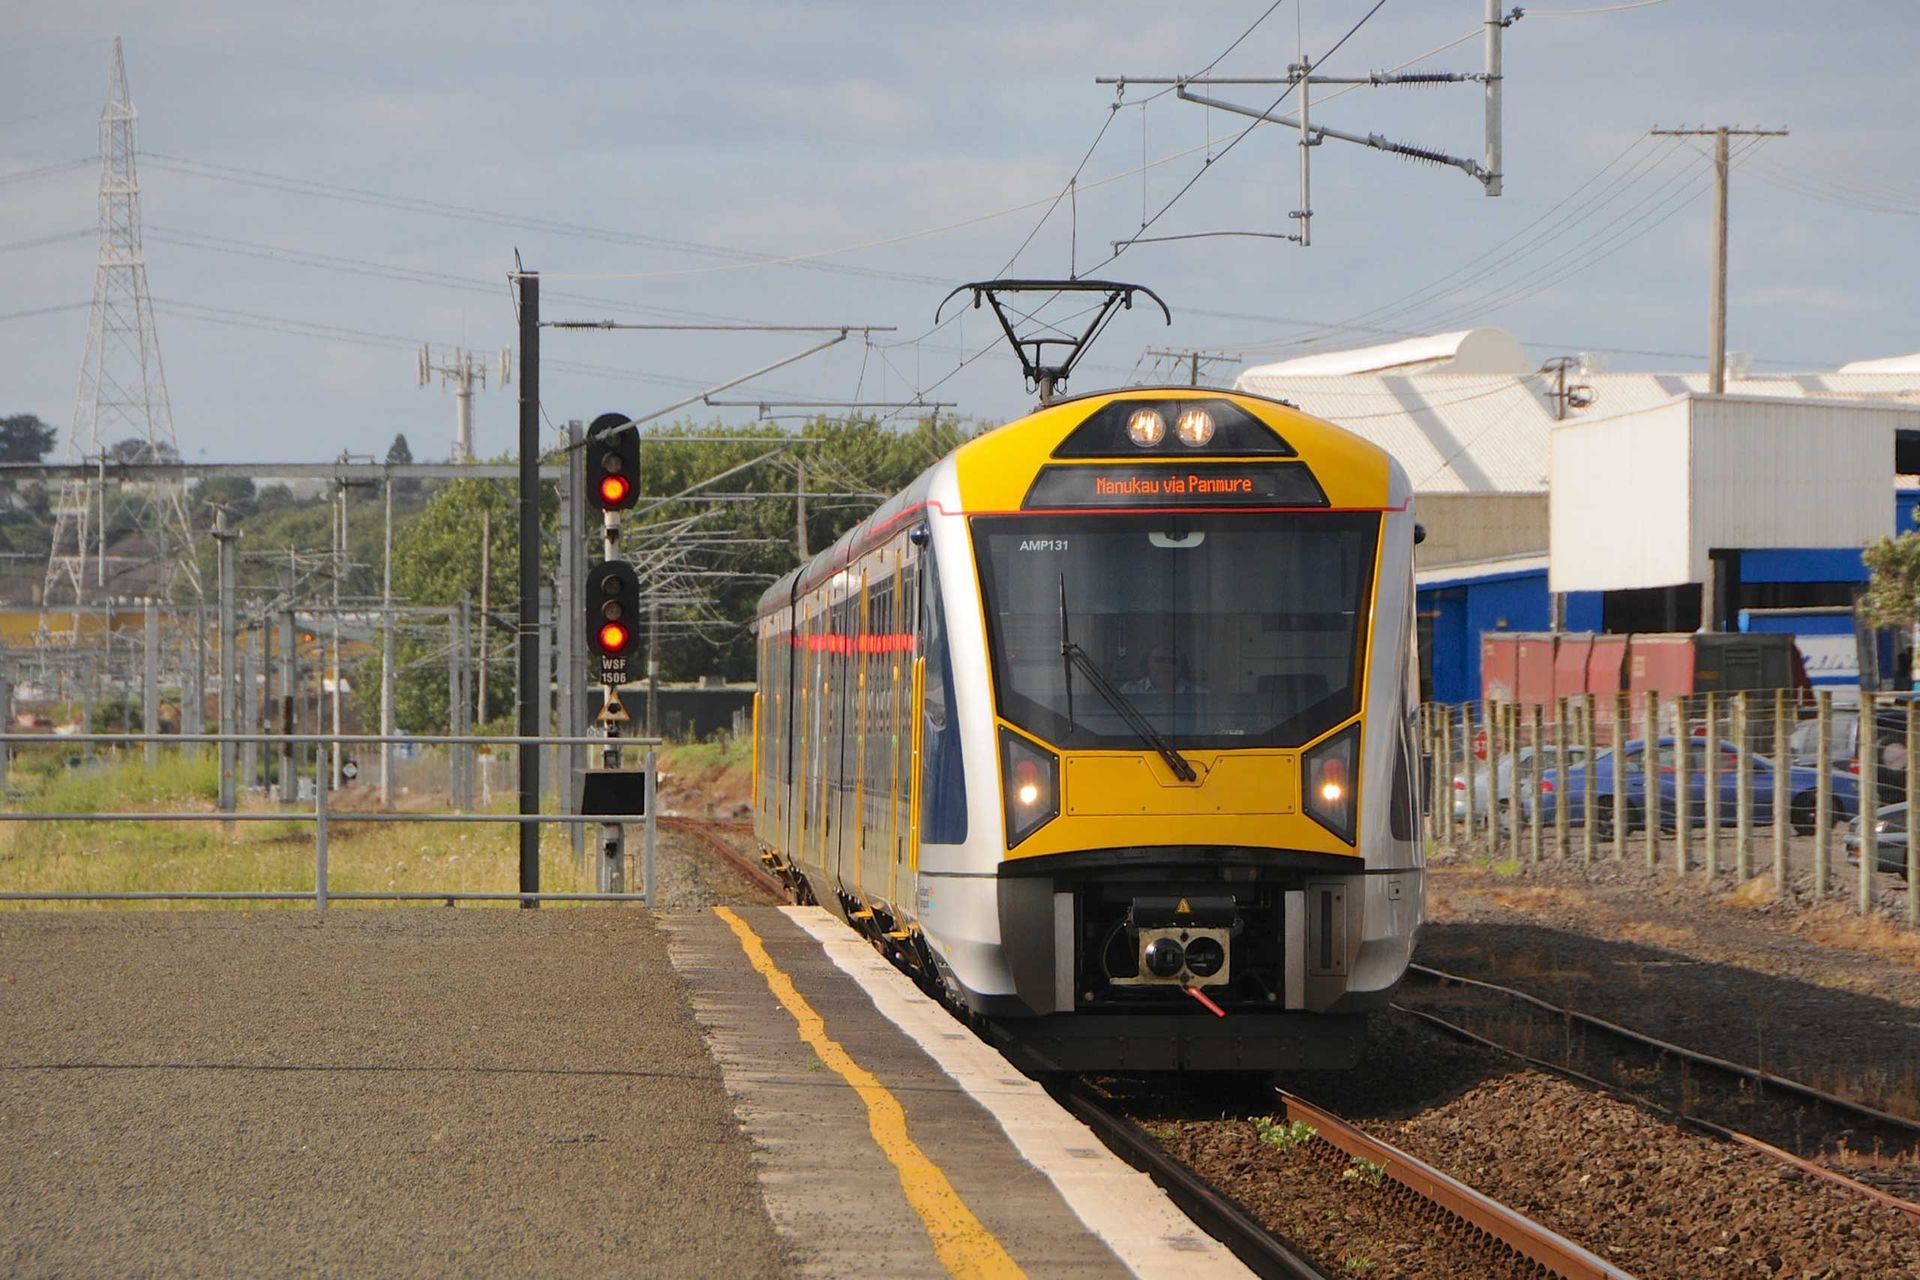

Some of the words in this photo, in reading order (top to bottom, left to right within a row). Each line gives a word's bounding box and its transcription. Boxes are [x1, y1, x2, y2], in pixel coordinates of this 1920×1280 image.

[1096, 477, 1159, 494] Manukau
[1163, 476, 1185, 493] via
[1188, 475, 1252, 492] Panmure
[1019, 540, 1068, 551] AMP131
[602, 659, 626, 670] WSF
[602, 672, 627, 683] 1506
